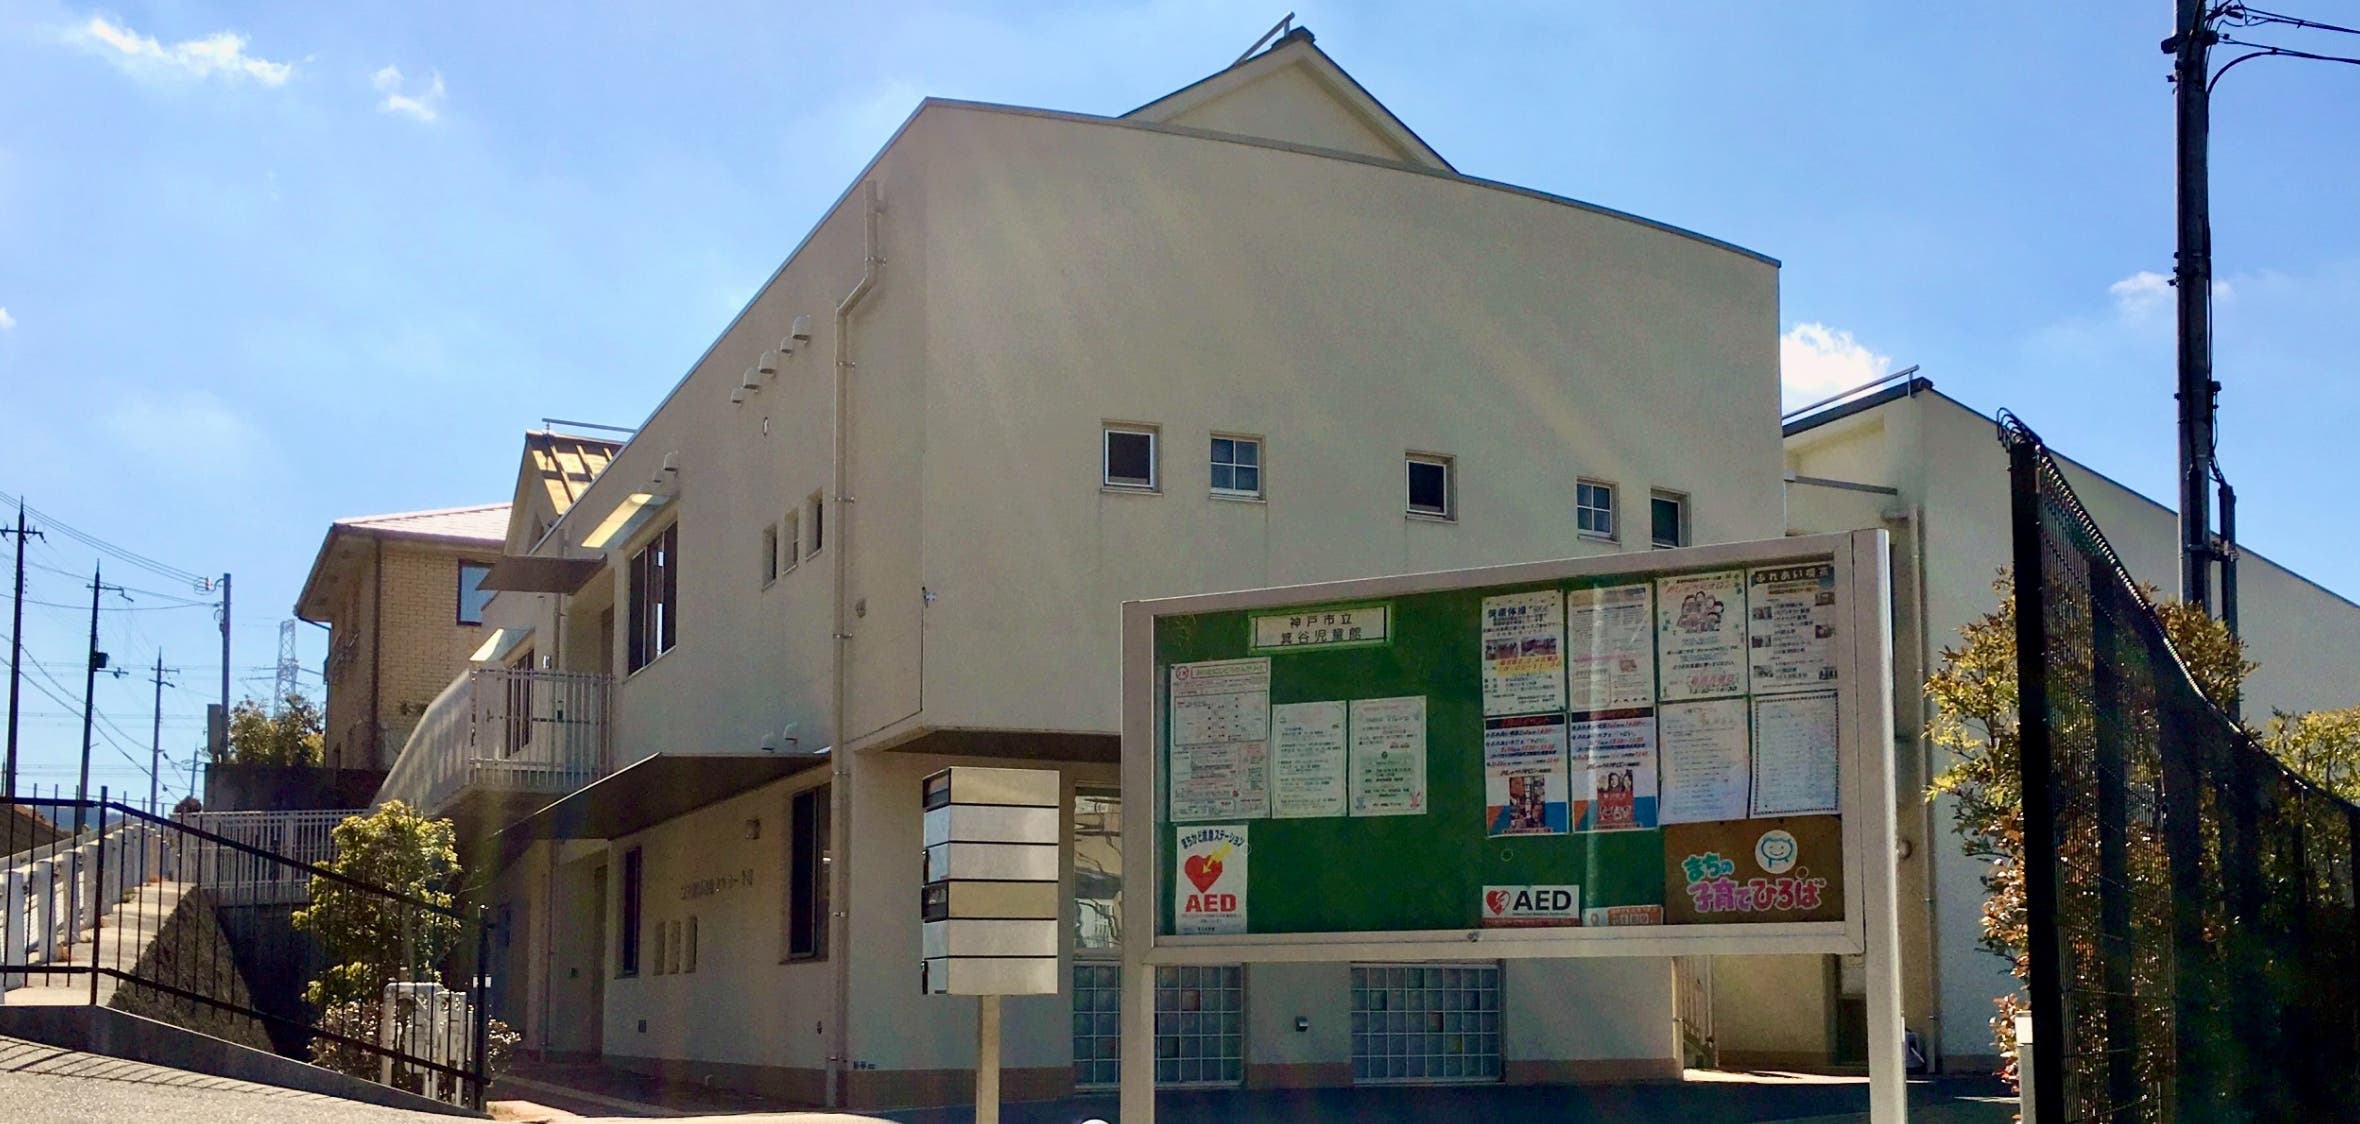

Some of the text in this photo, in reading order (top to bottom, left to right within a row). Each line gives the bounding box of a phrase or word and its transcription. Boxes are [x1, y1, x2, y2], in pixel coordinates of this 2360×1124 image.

[1290, 613, 1352, 628] 神戸市立
[1682, 852, 1735, 883] まちの
[1186, 894, 1237, 912] AED
[1512, 890, 1571, 910] AED
[1688, 877, 1822, 912] 子育てひろば
